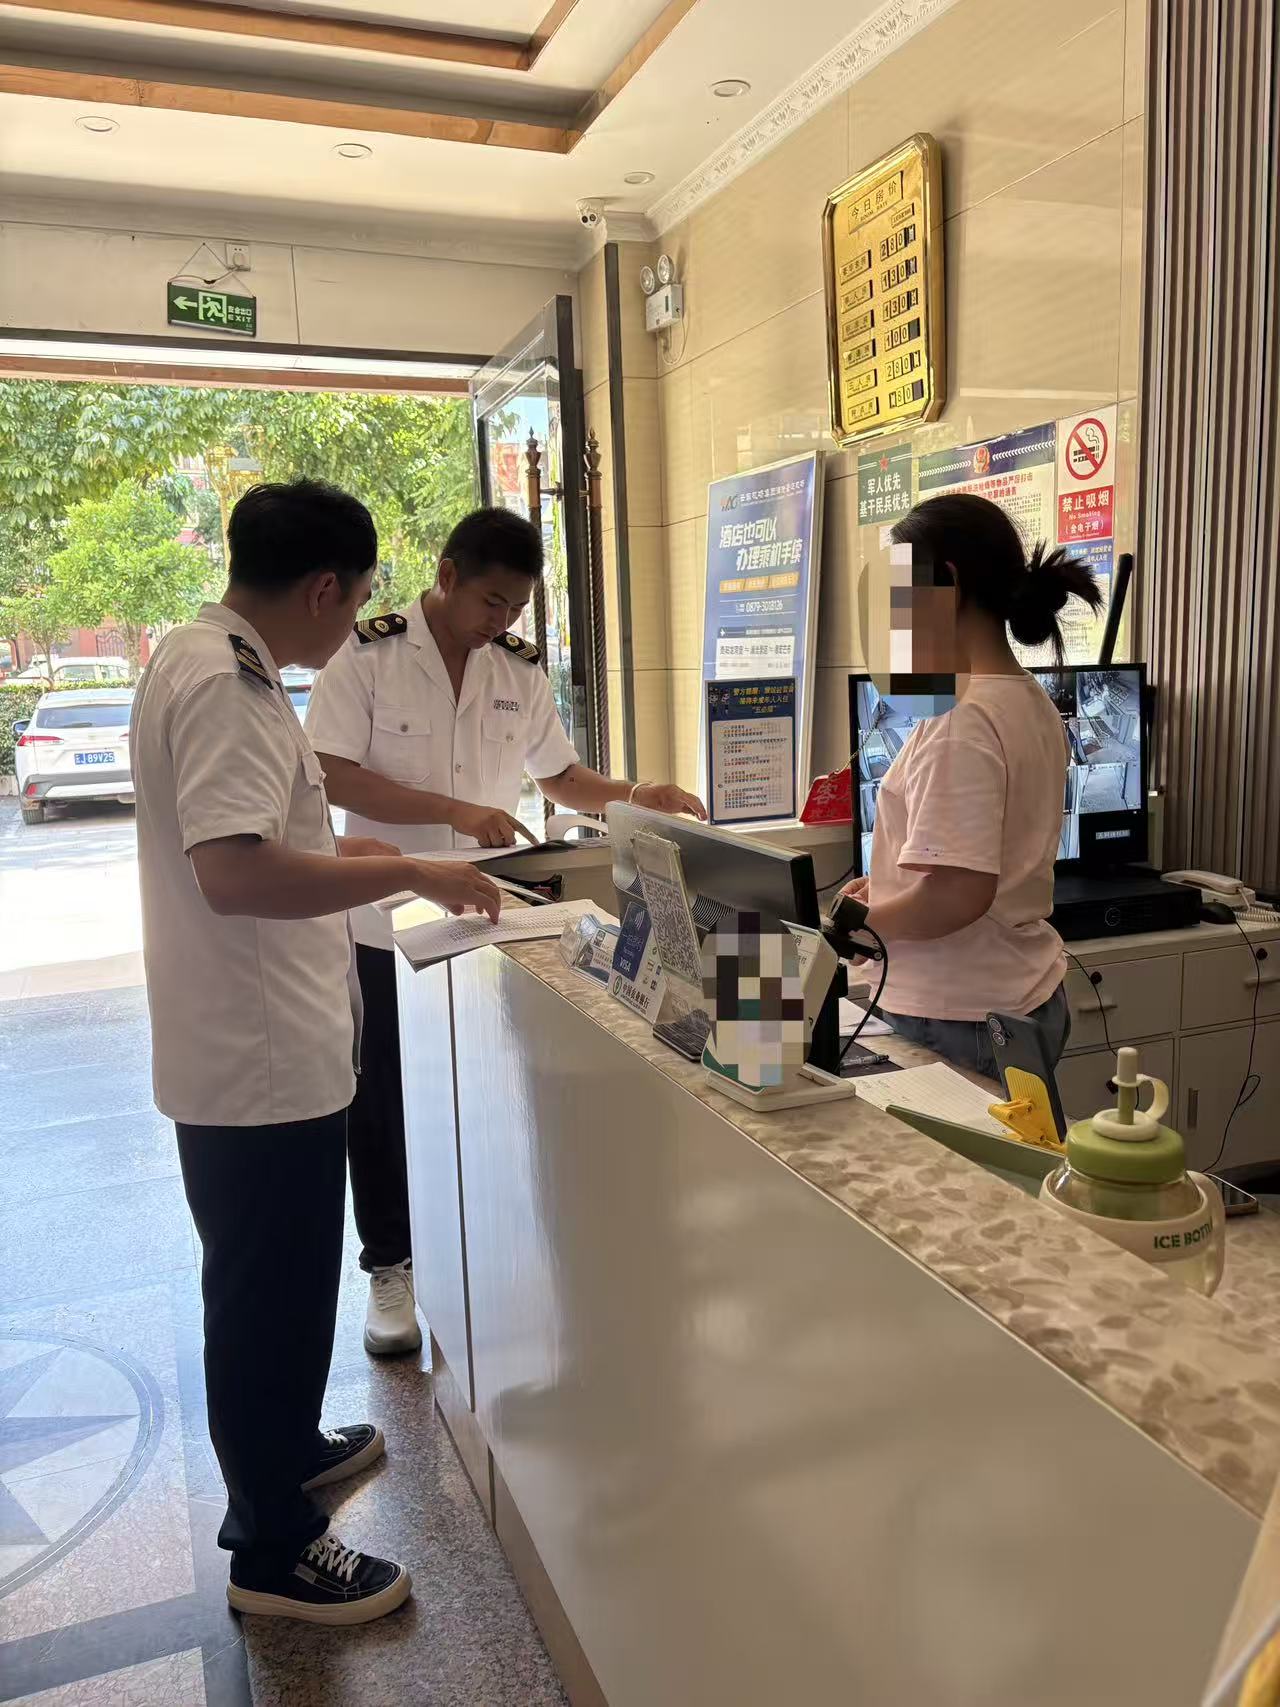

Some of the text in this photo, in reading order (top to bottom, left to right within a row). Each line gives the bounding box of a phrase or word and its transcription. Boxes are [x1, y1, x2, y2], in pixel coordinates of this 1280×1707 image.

[851, 180, 897, 219] 今日房价
[881, 233, 903, 257] 280
[882, 265, 905, 287] 130
[227, 305, 252, 316] 安全出口
[227, 314, 252, 322] EXIT
[884, 297, 906, 319] 130
[886, 327, 907, 349] 100
[887, 357, 909, 378] 280
[867, 473, 901, 496] 军人优先
[859, 493, 911, 518] 基干民兵优先
[1062, 490, 1110, 513] 禁止吸烟
[1077, 511, 1101, 519] Smoking
[719, 516, 778, 549] 酒店也可以
[735, 538, 803, 571] 办理乘机手续
[619, 956, 631, 972] VISA
[1154, 1234, 1181, 1249] ICE
